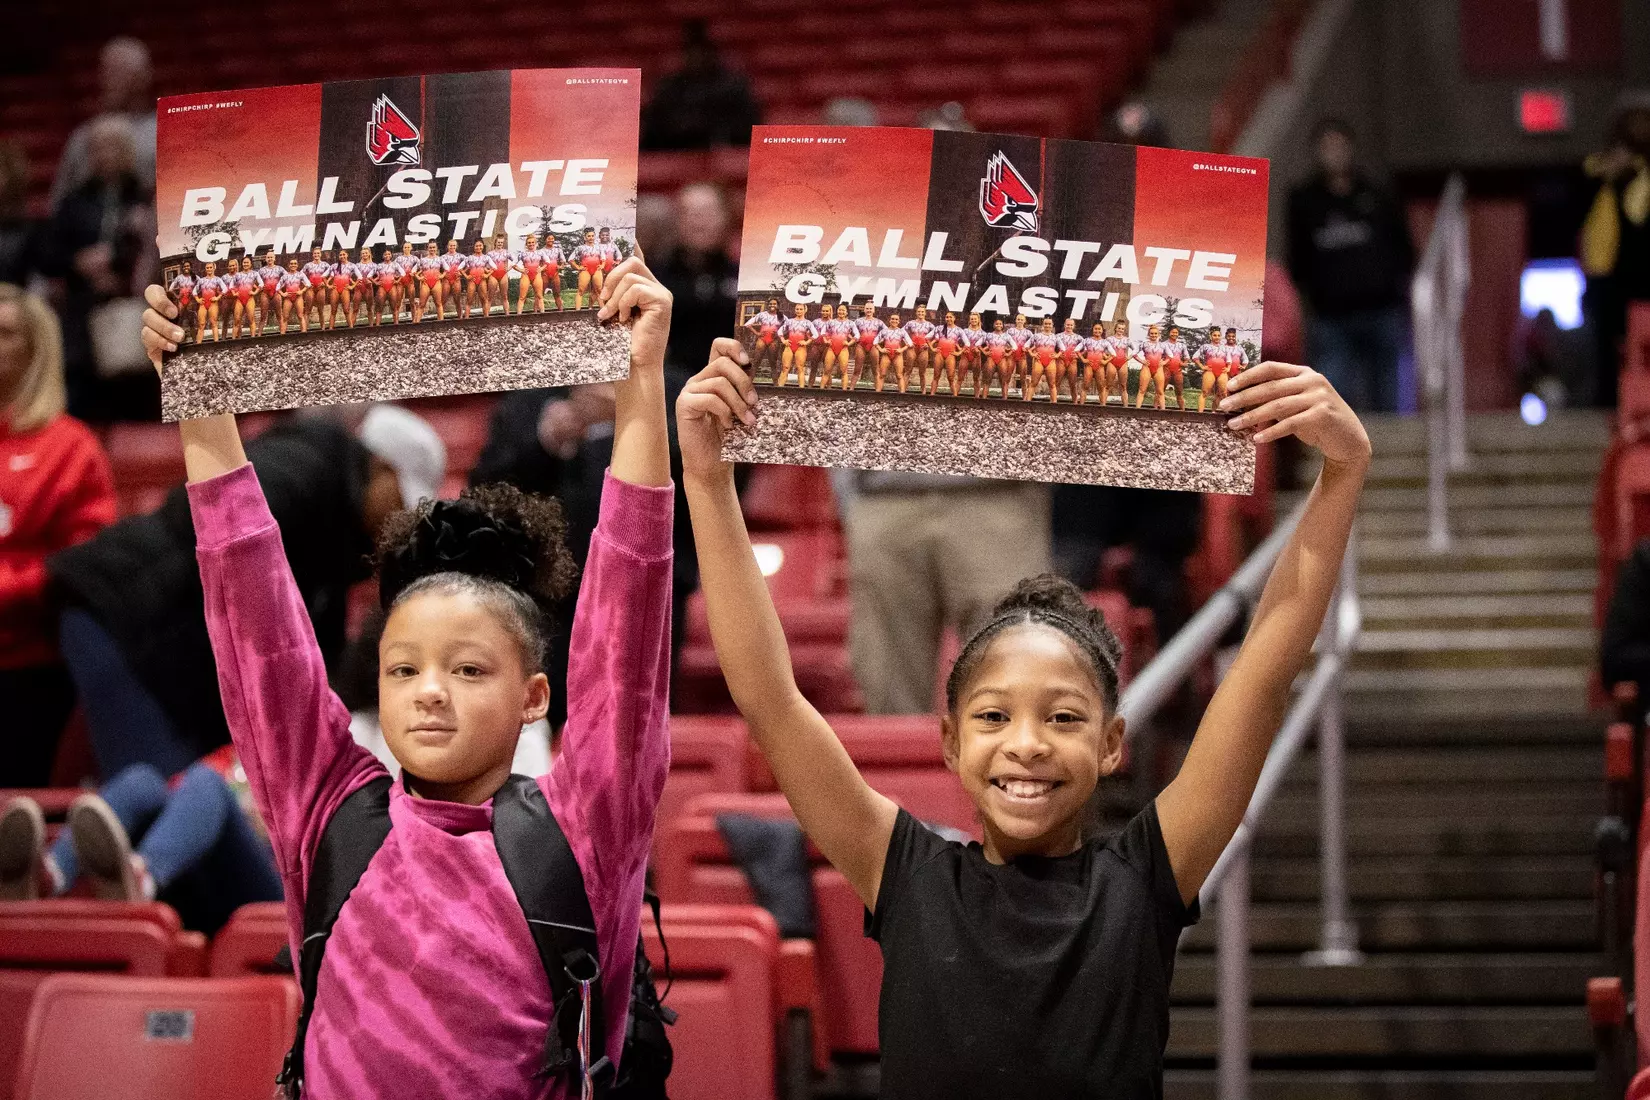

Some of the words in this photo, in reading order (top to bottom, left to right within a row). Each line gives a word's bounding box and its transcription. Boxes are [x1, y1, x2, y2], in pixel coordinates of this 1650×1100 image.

[167, 103, 214, 114] #CHIRPCHIRP
[215, 101, 243, 109] #WEFLY
[179, 176, 355, 228] BALL
[383, 158, 610, 209] STATE
[1192, 163, 1257, 175] @BALLSTATEGYM
[195, 203, 588, 263] GYMNASTICS
[768, 224, 965, 273] BALL
[995, 235, 1237, 292] STATE
[785, 272, 1215, 329] GYMNASTICS
